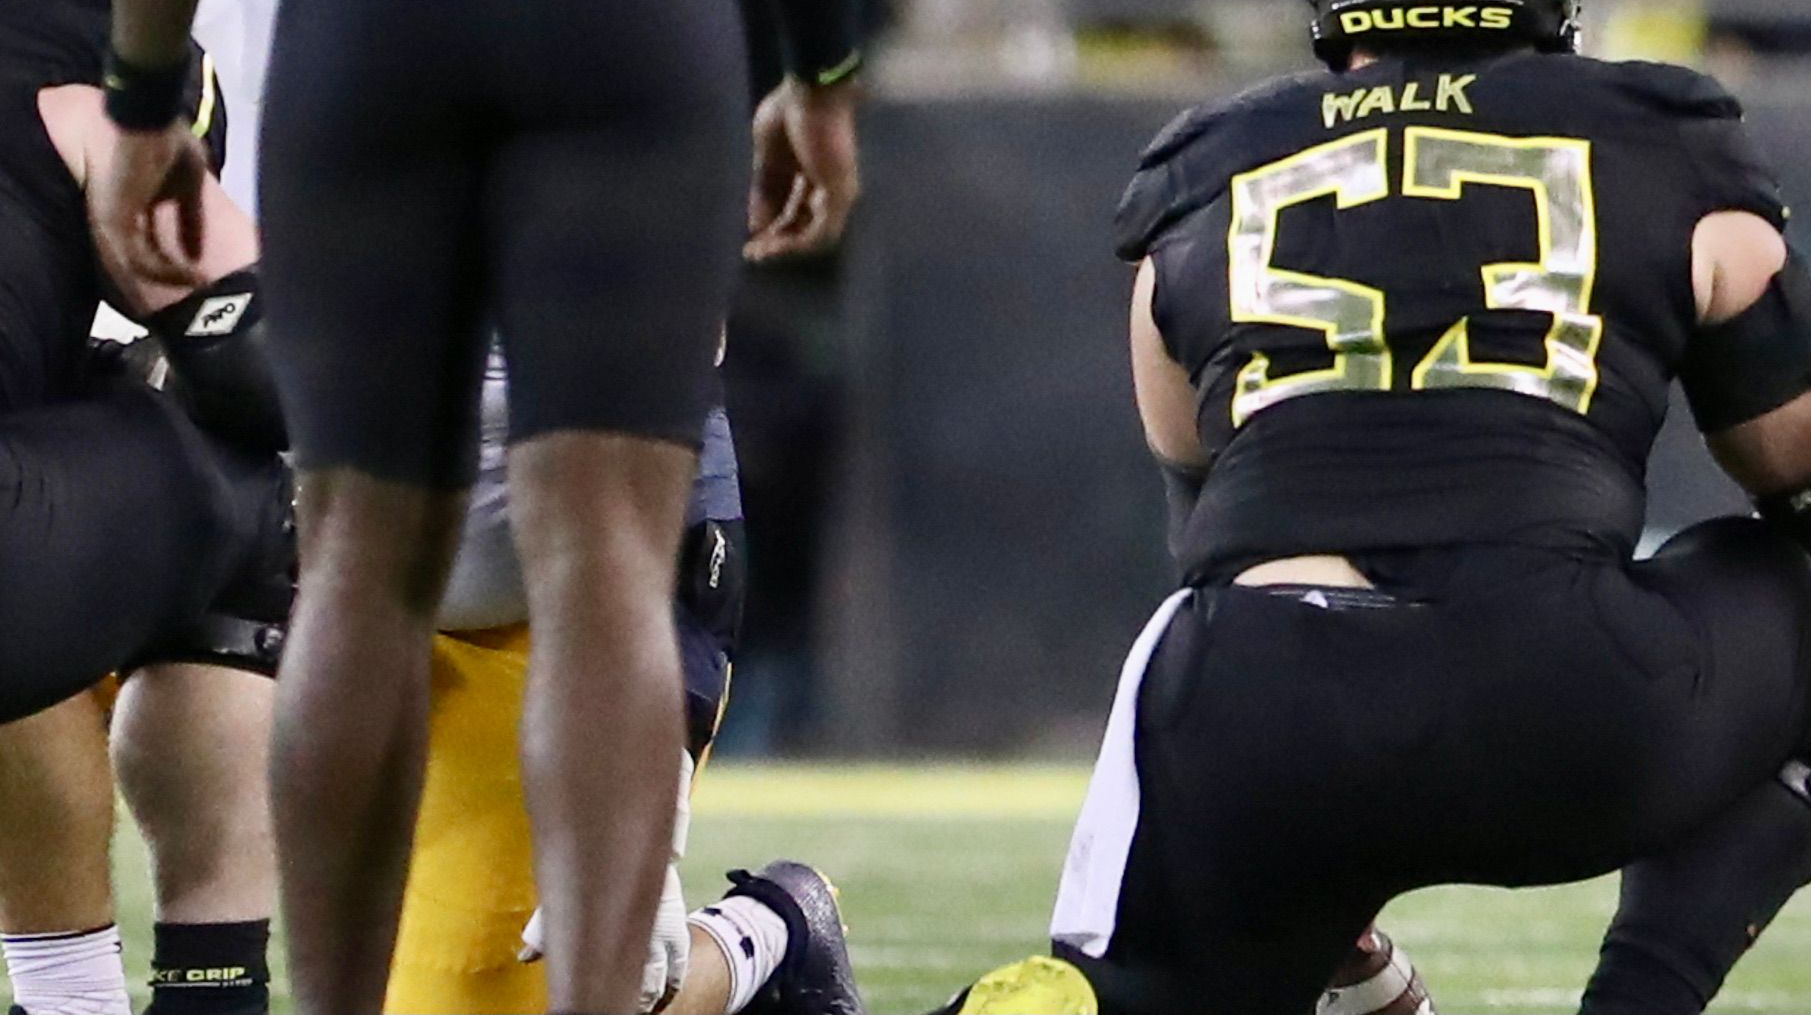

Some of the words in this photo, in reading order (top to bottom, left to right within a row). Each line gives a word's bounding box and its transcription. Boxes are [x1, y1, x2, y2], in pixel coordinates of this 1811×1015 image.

[1340, 7, 1513, 34] DUCKS
[1322, 74, 1477, 126] WALK
[1229, 126, 1602, 429] 53
[186, 967, 245, 982] GRIP
